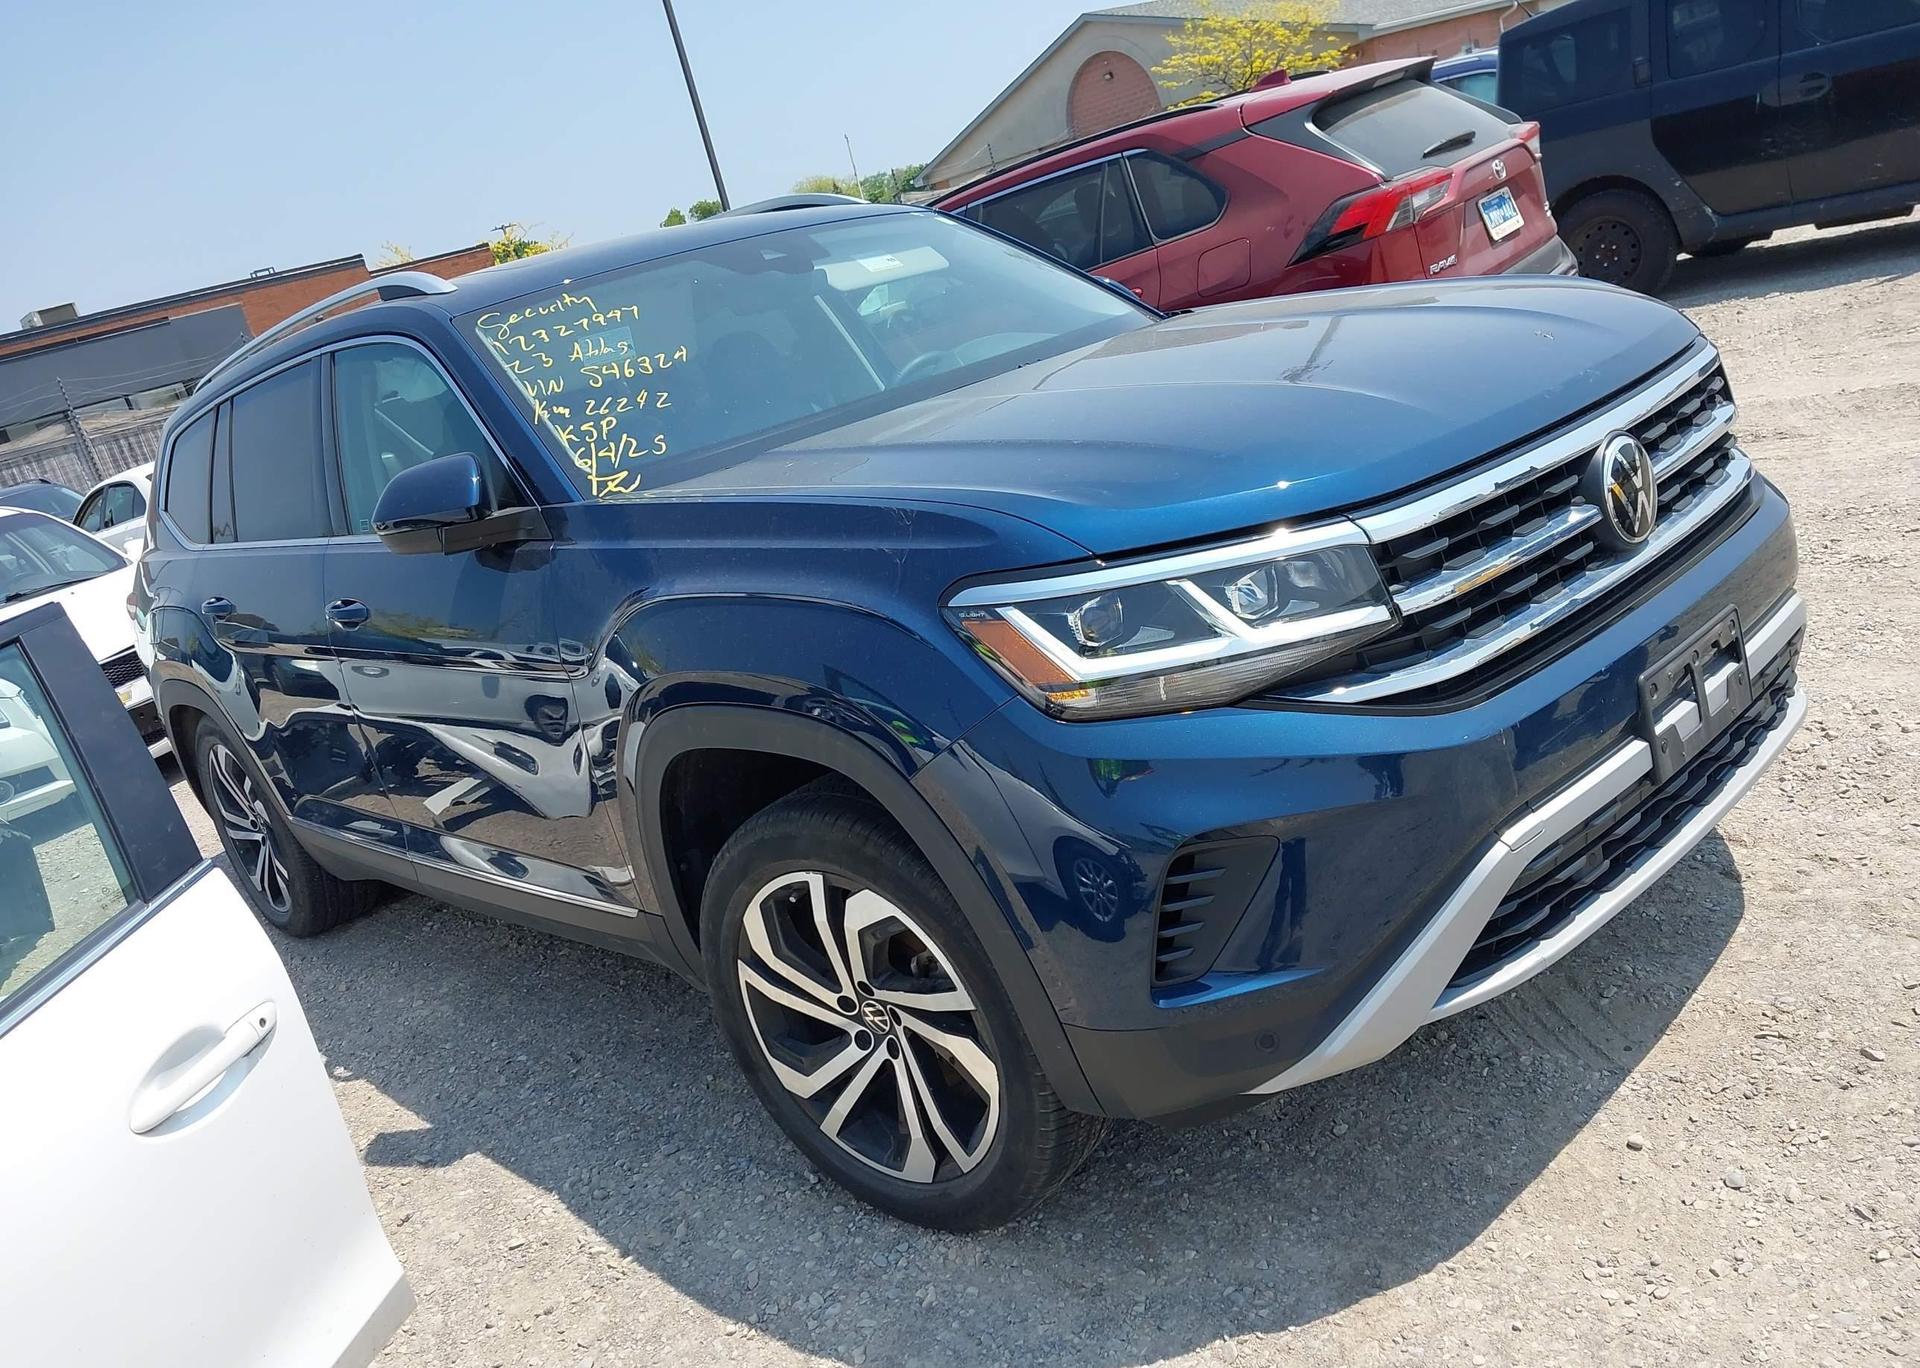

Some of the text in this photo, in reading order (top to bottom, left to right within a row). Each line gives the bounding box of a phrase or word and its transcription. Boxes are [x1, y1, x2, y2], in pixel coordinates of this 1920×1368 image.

[1428, 253, 1458, 276] RAV4
[476, 292, 598, 340] Security
[504, 351, 554, 375] 23
[523, 375, 565, 397] VIN
